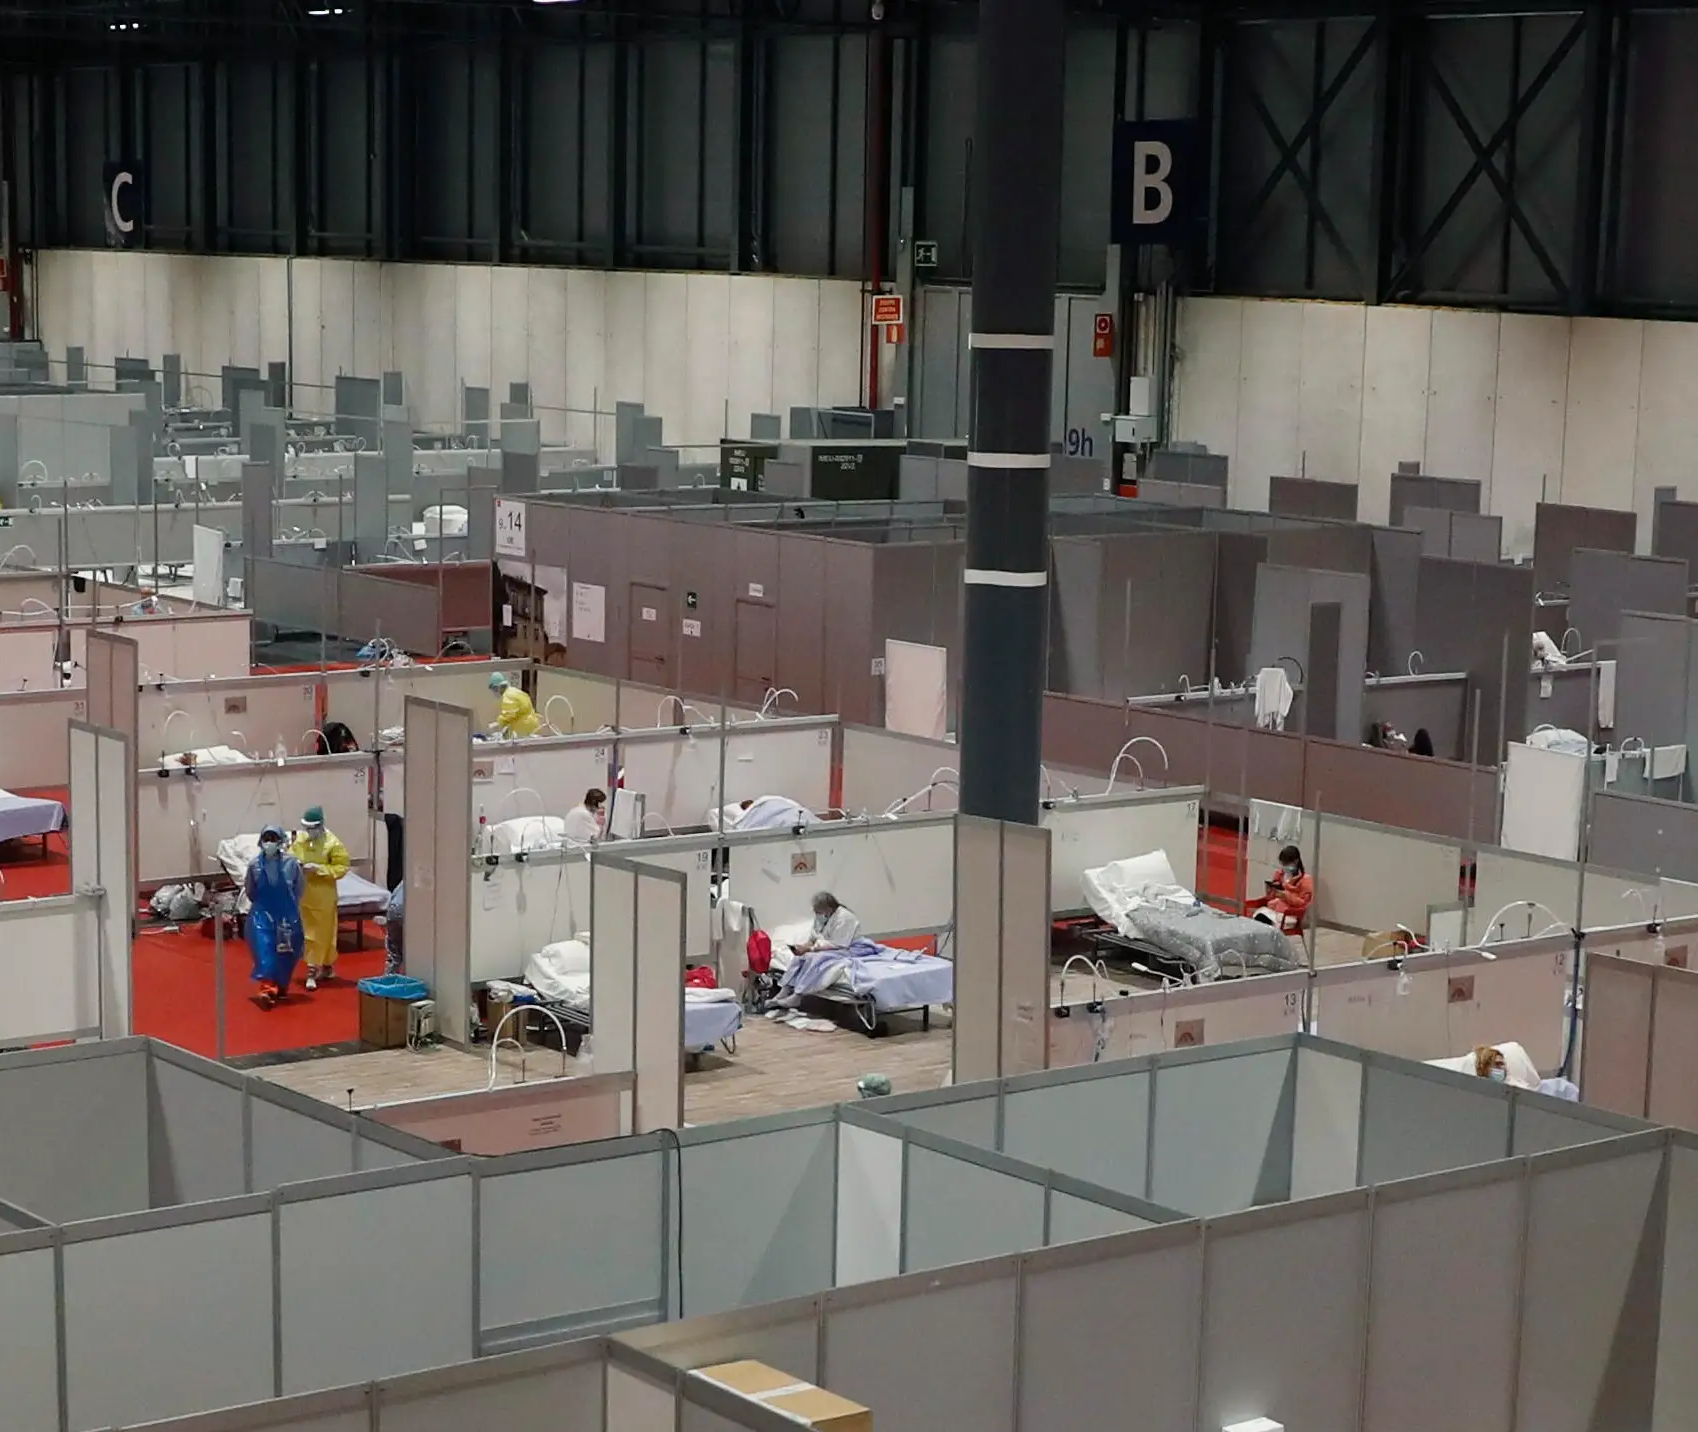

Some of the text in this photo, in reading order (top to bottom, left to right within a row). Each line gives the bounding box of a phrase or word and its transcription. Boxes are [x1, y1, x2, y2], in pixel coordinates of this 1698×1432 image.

[112, 172, 134, 232] C
[1133, 140, 1174, 225] B
[1068, 428, 1093, 457] 9h
[1285, 993, 1297, 1006] 13
